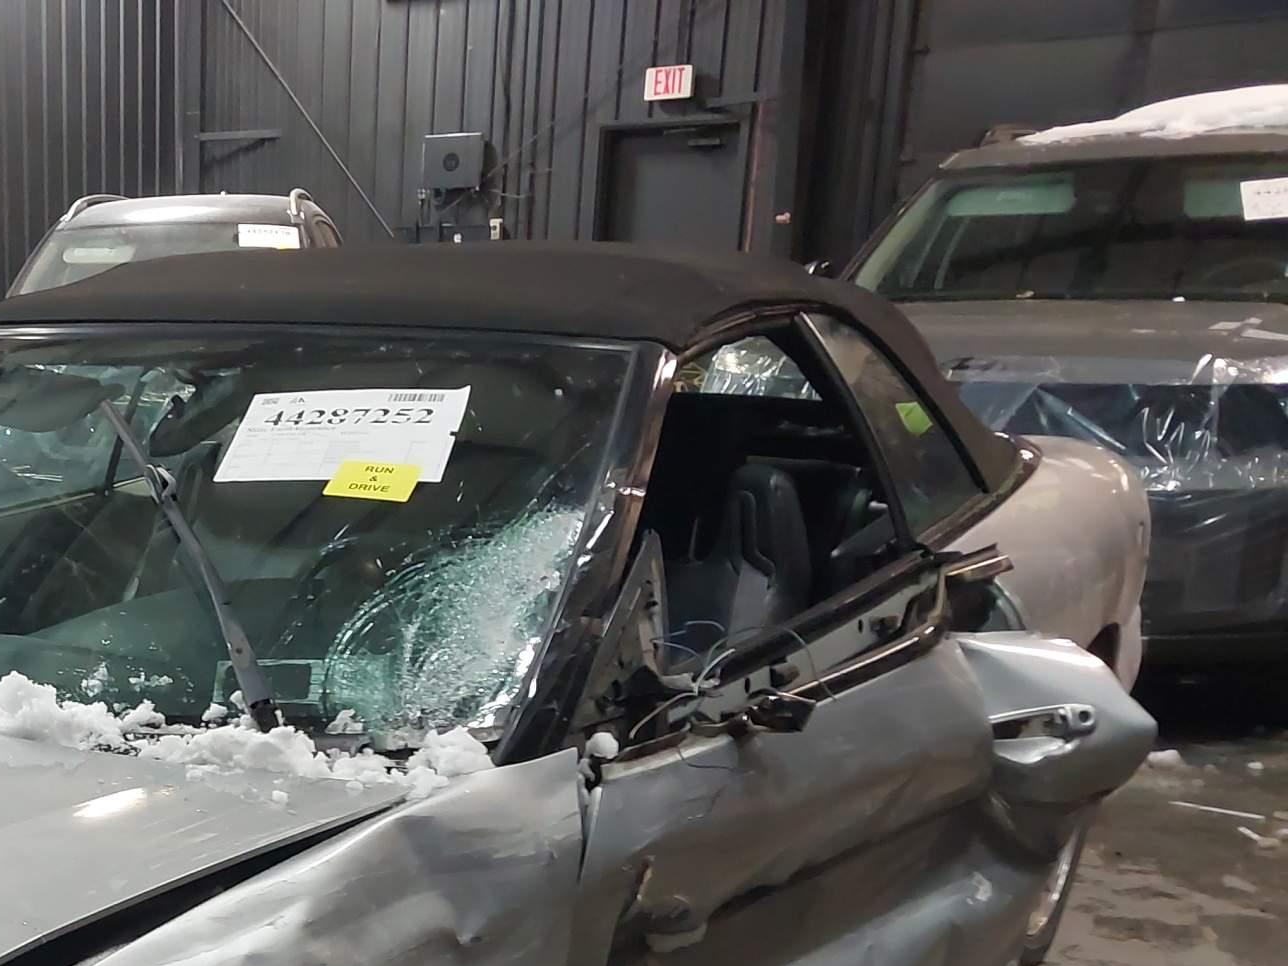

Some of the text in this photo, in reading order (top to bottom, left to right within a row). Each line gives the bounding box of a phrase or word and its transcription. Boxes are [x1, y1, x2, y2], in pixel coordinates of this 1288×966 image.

[654, 67, 685, 96] EXIT
[264, 408, 434, 426] 44287252
[365, 465, 394, 474] RUN
[348, 483, 390, 493] DRIVE
